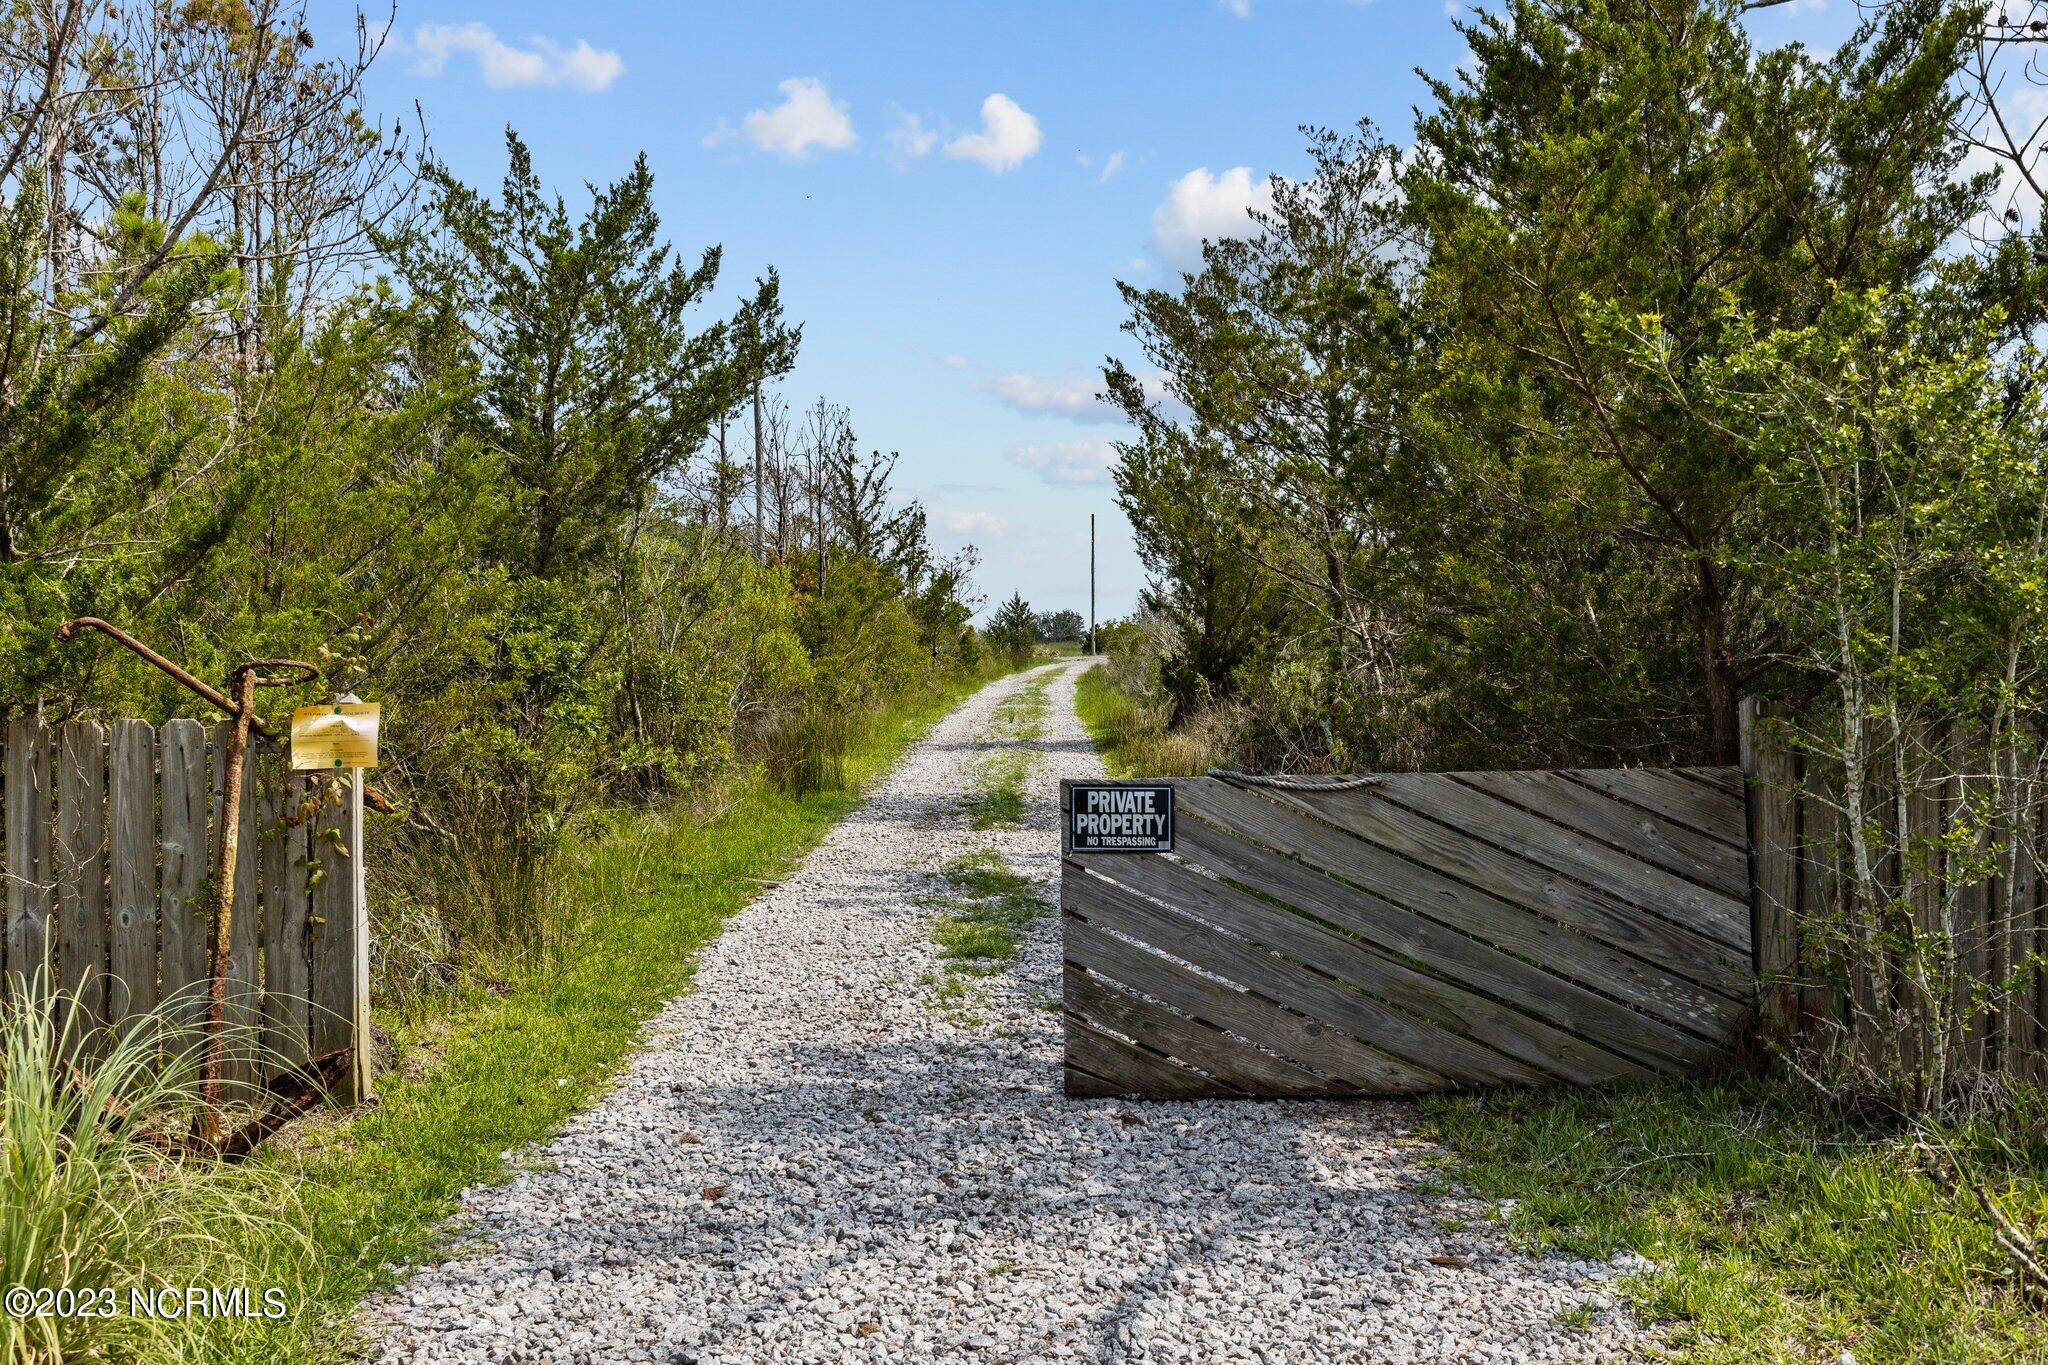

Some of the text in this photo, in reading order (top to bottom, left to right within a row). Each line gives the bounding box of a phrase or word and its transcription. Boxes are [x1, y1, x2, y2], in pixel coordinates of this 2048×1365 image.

[1087, 791, 1155, 813] PRIVATE
[1077, 813, 1165, 835] PROPERTY
[1087, 836, 1156, 847] NO TRESPASSING
